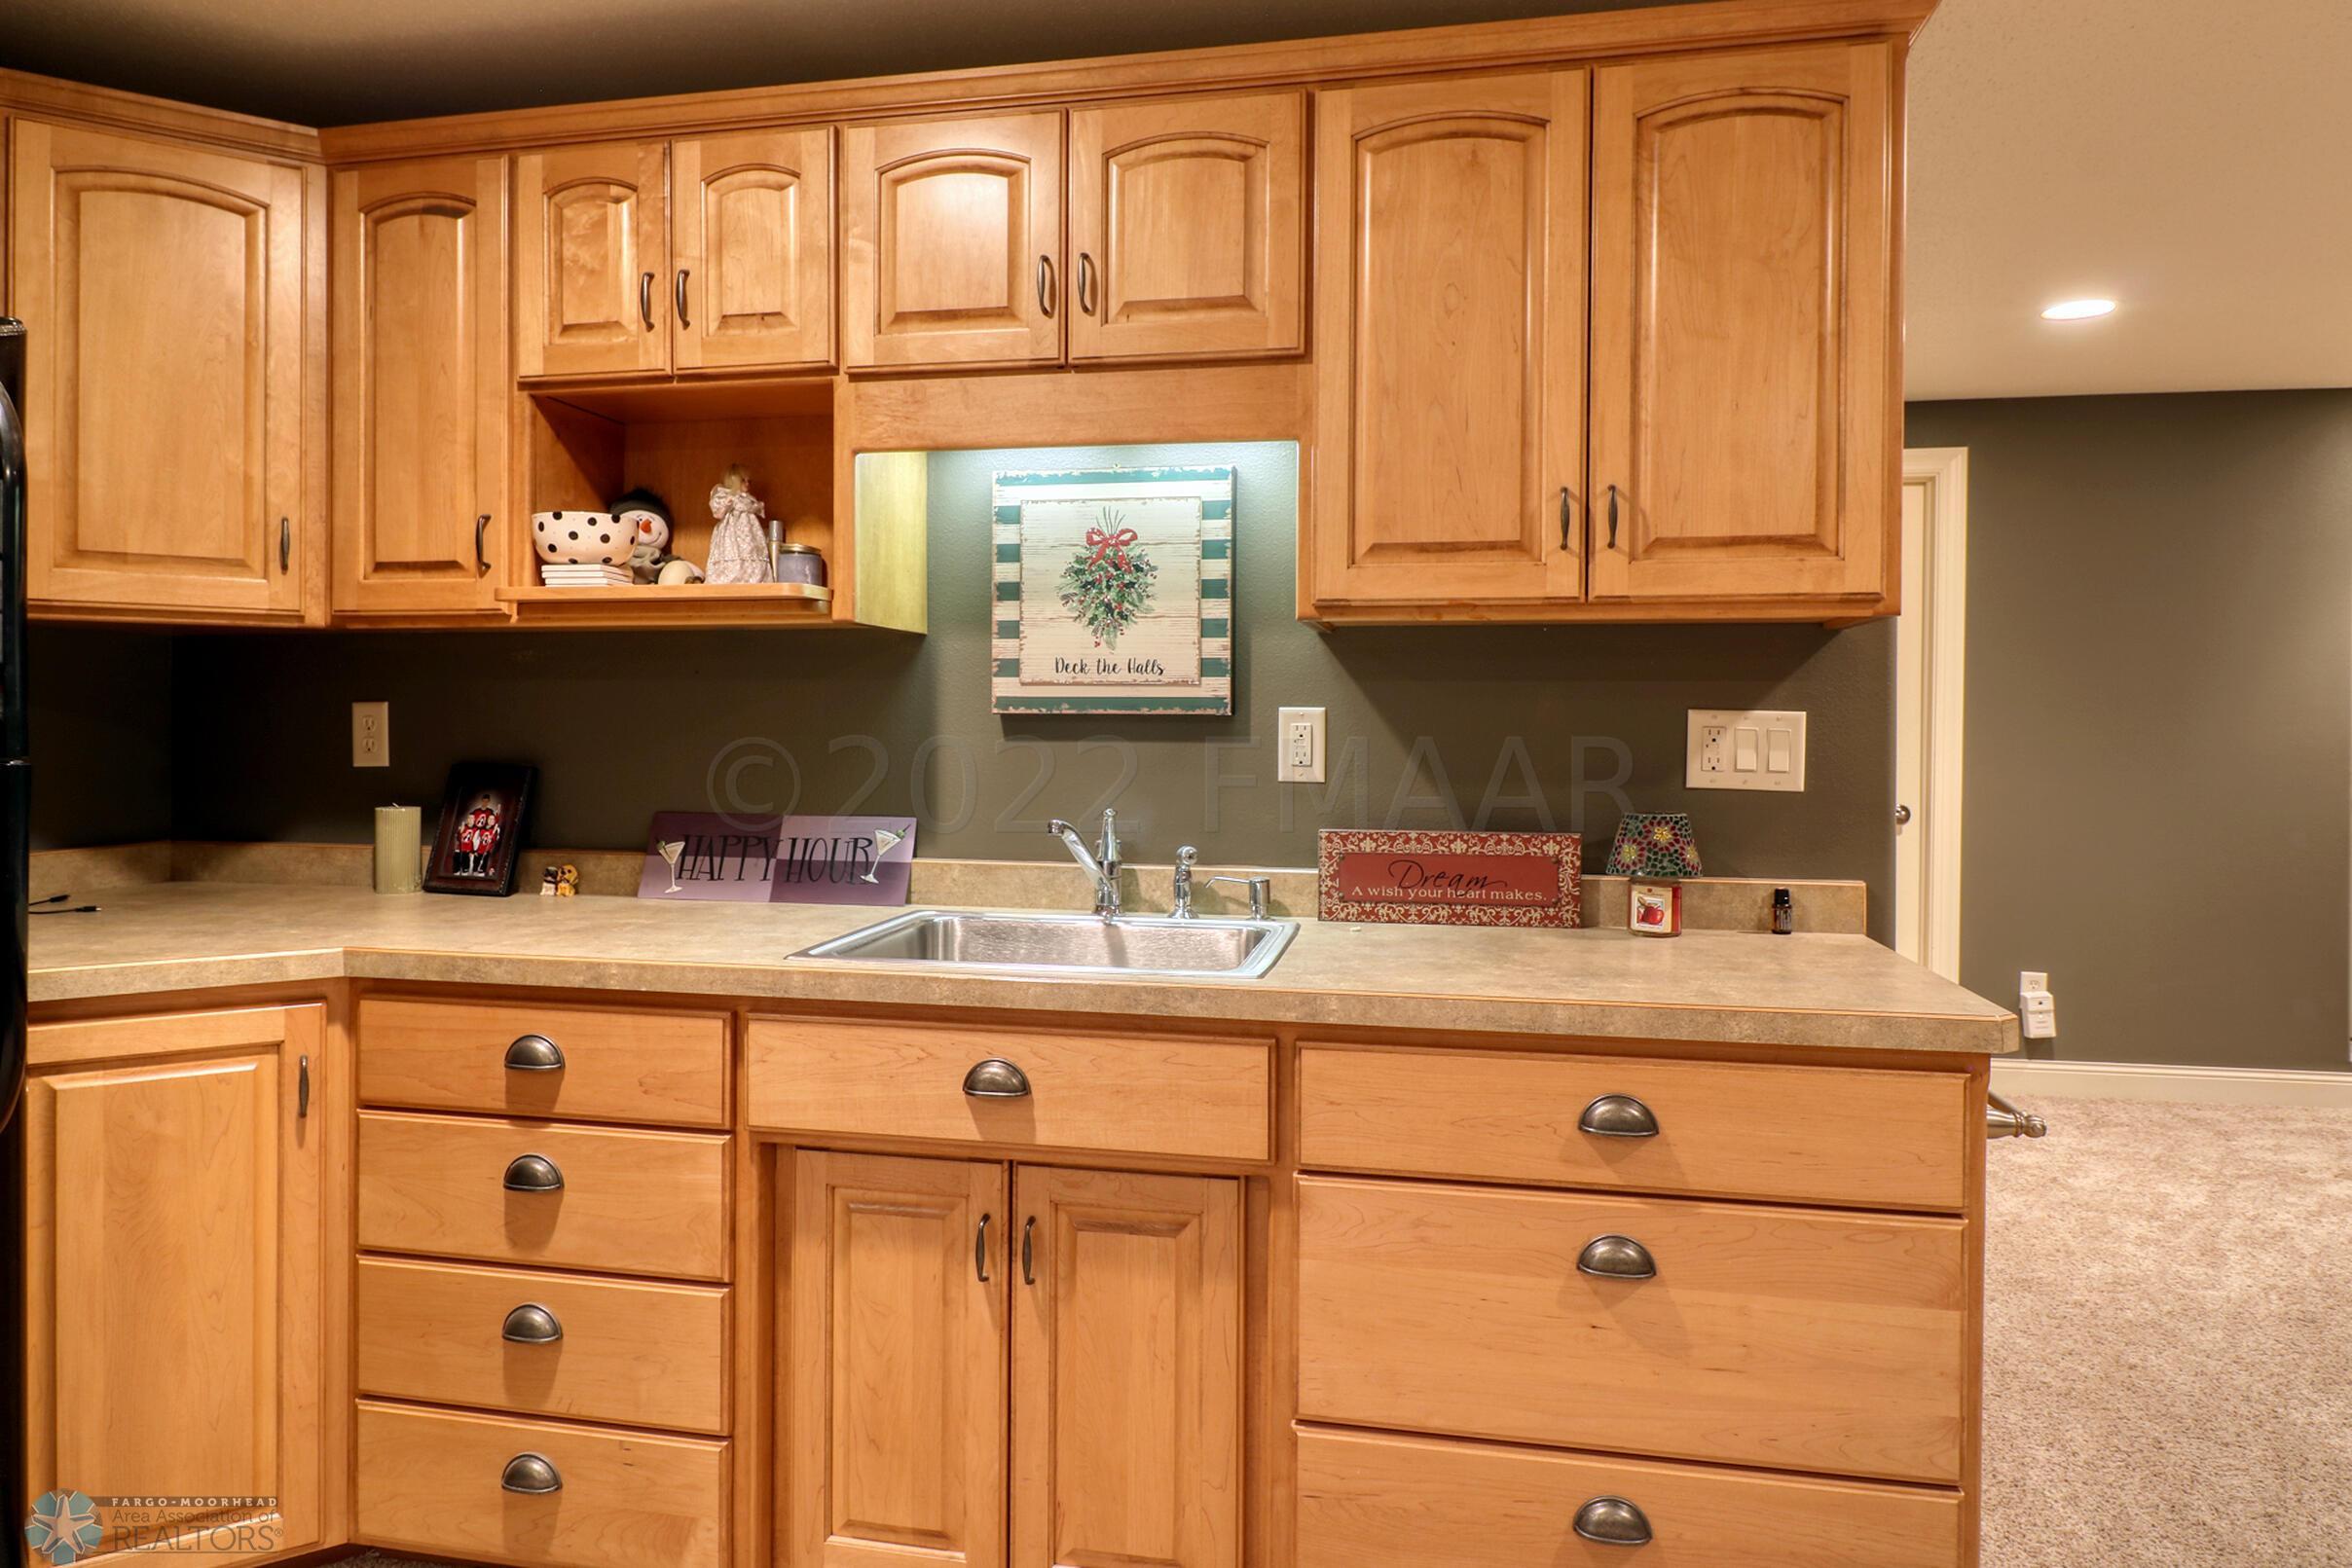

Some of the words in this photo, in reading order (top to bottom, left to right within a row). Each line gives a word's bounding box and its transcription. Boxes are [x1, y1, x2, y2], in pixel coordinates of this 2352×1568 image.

[1054, 657, 1090, 675] Deck
[1096, 657, 1121, 675] the
[1127, 658, 1165, 675] Halls
[677, 834, 783, 882] HAPPY
[784, 836, 875, 885] HOUR
[1387, 859, 1508, 897] Dream
[1351, 887, 1363, 896] A
[1368, 887, 1404, 897] wish
[1407, 888, 1446, 901] your
[1450, 888, 1488, 900] heart
[1490, 890, 1547, 901] makes.
